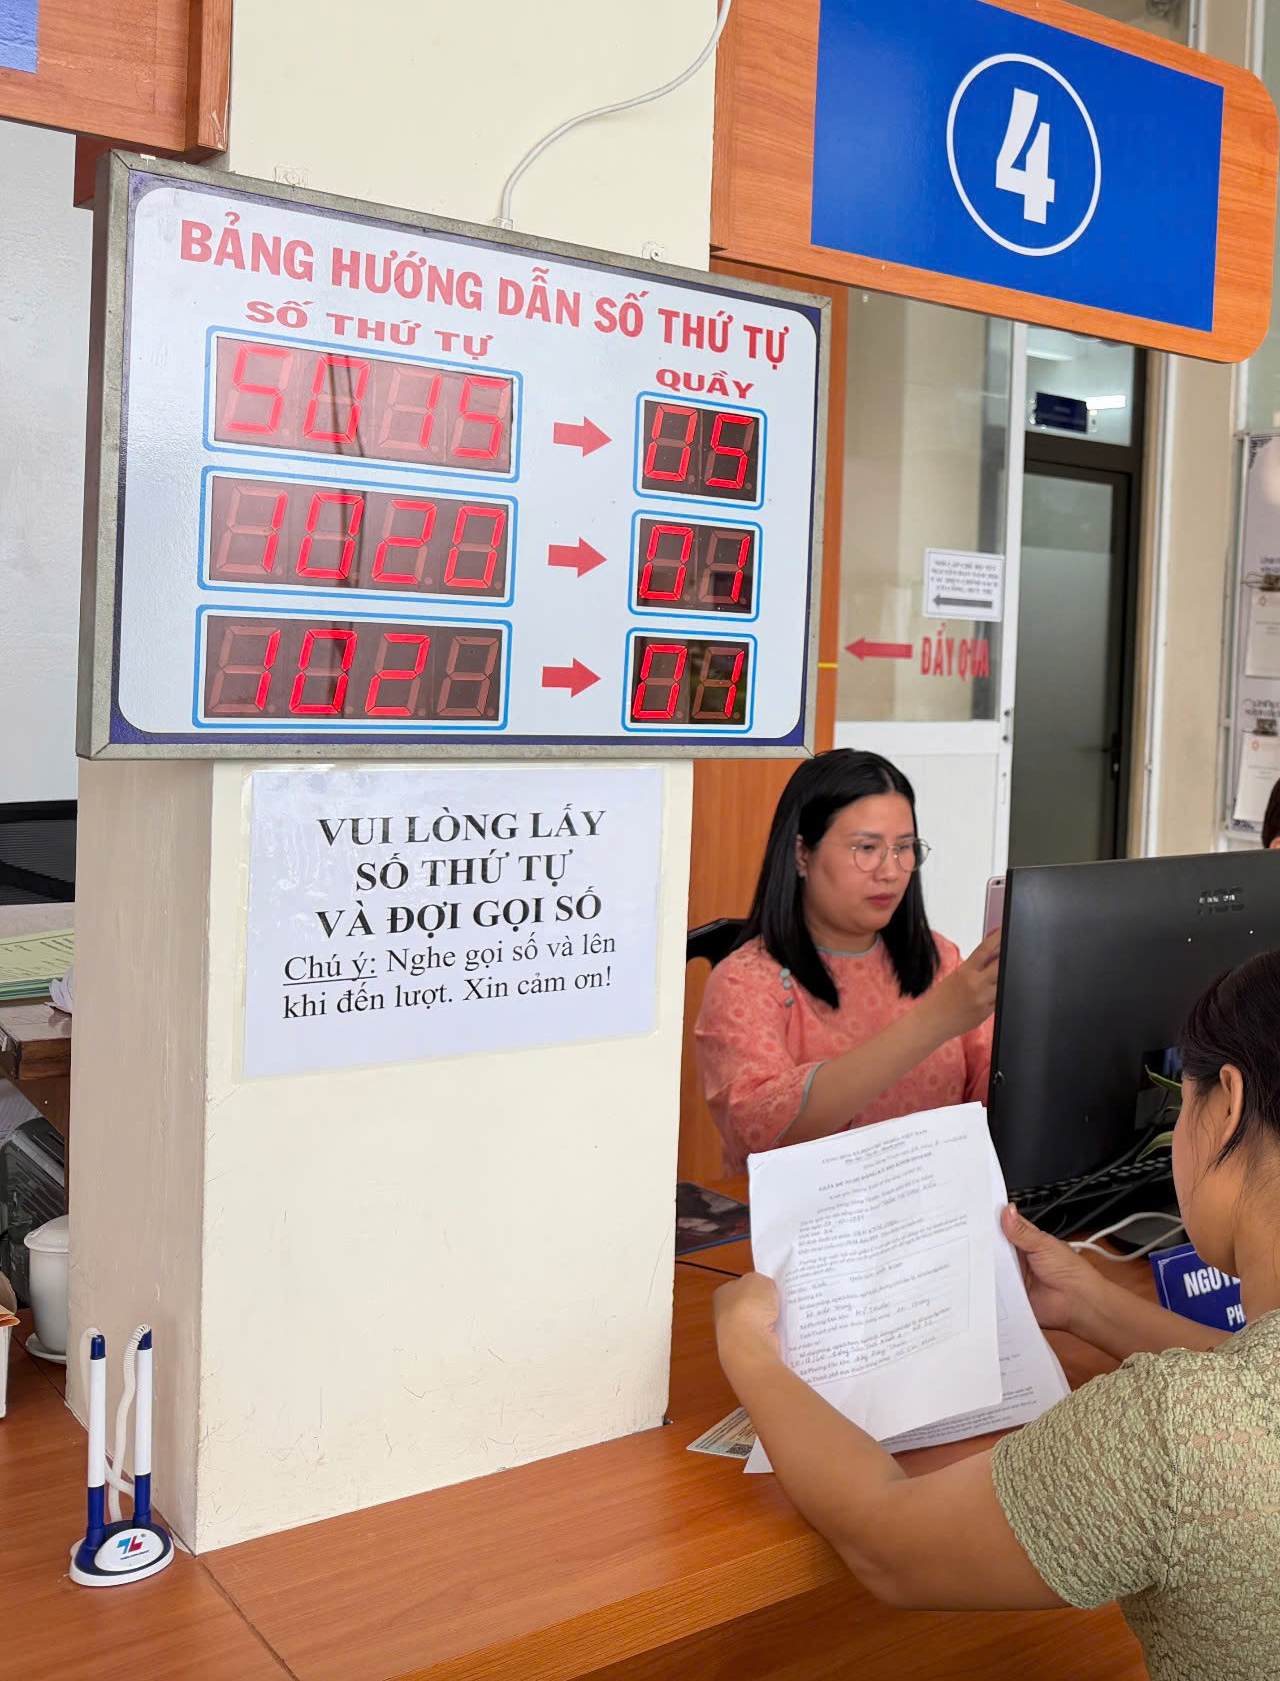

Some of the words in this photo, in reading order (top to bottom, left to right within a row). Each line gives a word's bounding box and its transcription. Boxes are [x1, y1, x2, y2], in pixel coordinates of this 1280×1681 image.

[995, 87, 1055, 225] 4
[180, 211, 314, 283] BẢNG
[331, 248, 483, 312] HƯỚNG
[498, 266, 581, 328] DẪN
[593, 290, 649, 338] SỐ
[658, 309, 734, 354] THỨ
[743, 325, 790, 369] TỰ
[245, 300, 315, 329] SỐ
[326, 314, 420, 346] THỨ
[442, 331, 493, 361] TỰ
[226, 345, 510, 460] 5015
[656, 367, 756, 399] QUẦY
[645, 404, 754, 489] 05
[264, 492, 507, 589] 1020
[639, 524, 751, 602] 01
[632, 643, 744, 719] 01
[957, 638, 990, 681] QUA
[317, 815, 393, 846] VUI
[405, 807, 519, 843] LÒNG
[528, 803, 607, 839] LẤY
[355, 853, 409, 892] SỐ
[421, 849, 511, 887] THỨ
[518, 849, 574, 888] TỰ
[315, 900, 375, 939] VÀ
[386, 900, 461, 938] ĐỢI
[473, 896, 544, 933] GỌI
[554, 885, 602, 921] SỐ
[284, 953, 342, 982] Chú
[350, 951, 377, 983] ý:
[386, 948, 456, 978] Nghe
[464, 941, 503, 970] gọi
[512, 932, 540, 961] số
[547, 937, 574, 958] và
[580, 933, 617, 956] lên
[283, 994, 328, 1020] khi
[337, 980, 385, 1013] đến
[394, 985, 454, 1010] lượt.
[463, 976, 509, 1002] Xin
[517, 972, 566, 995] cảm
[573, 965, 613, 989] ơn!
[1226, 1304, 1246, 1327] PH
